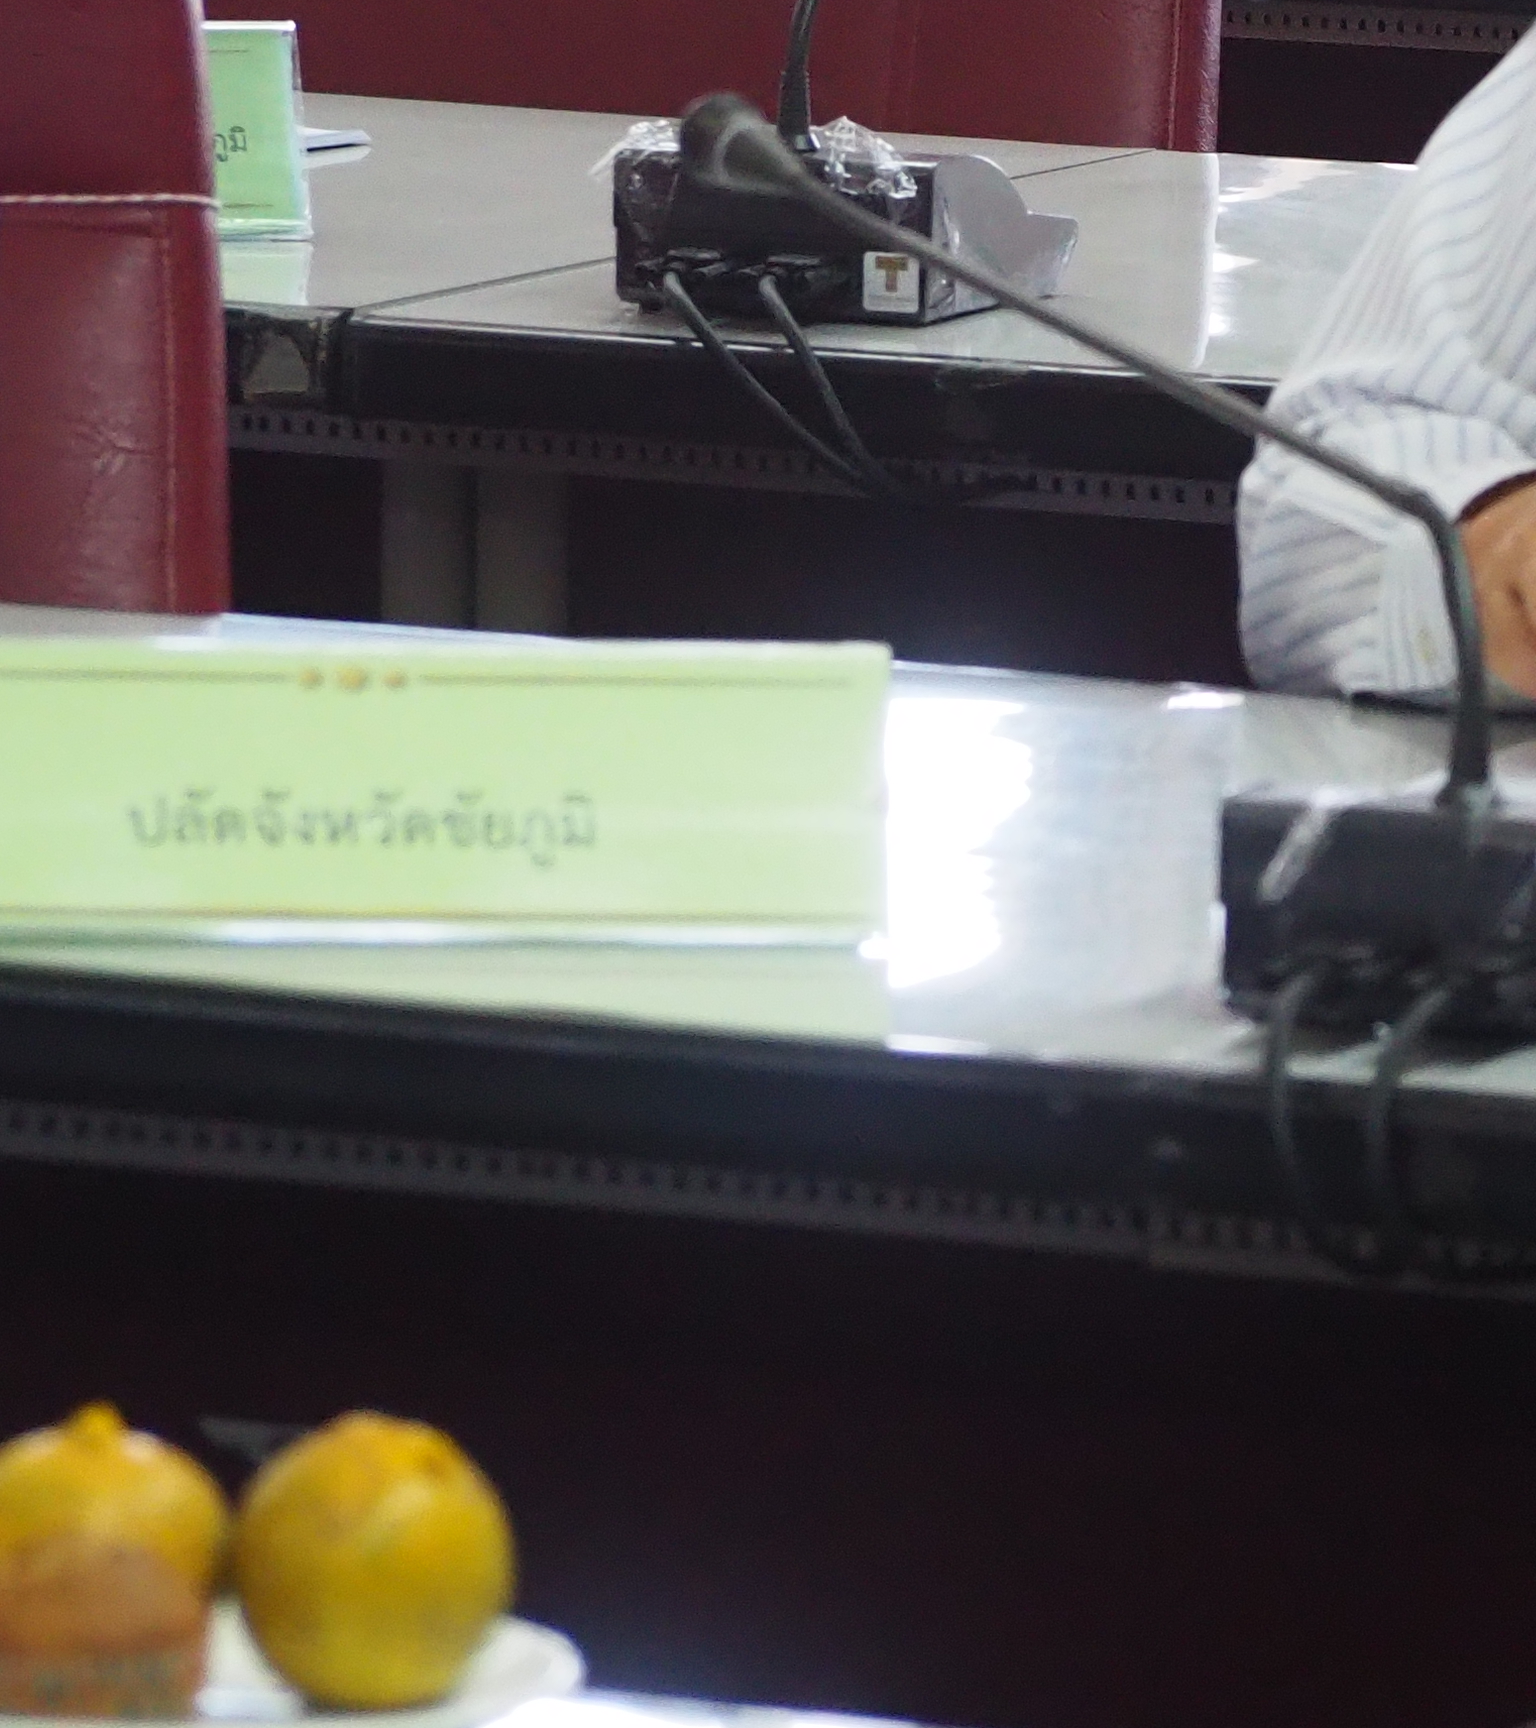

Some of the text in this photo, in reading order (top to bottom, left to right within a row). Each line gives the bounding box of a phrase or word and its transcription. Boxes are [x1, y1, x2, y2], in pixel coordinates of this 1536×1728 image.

[127, 786, 597, 868] ปลัดจังหวัดชัยภูมิ
